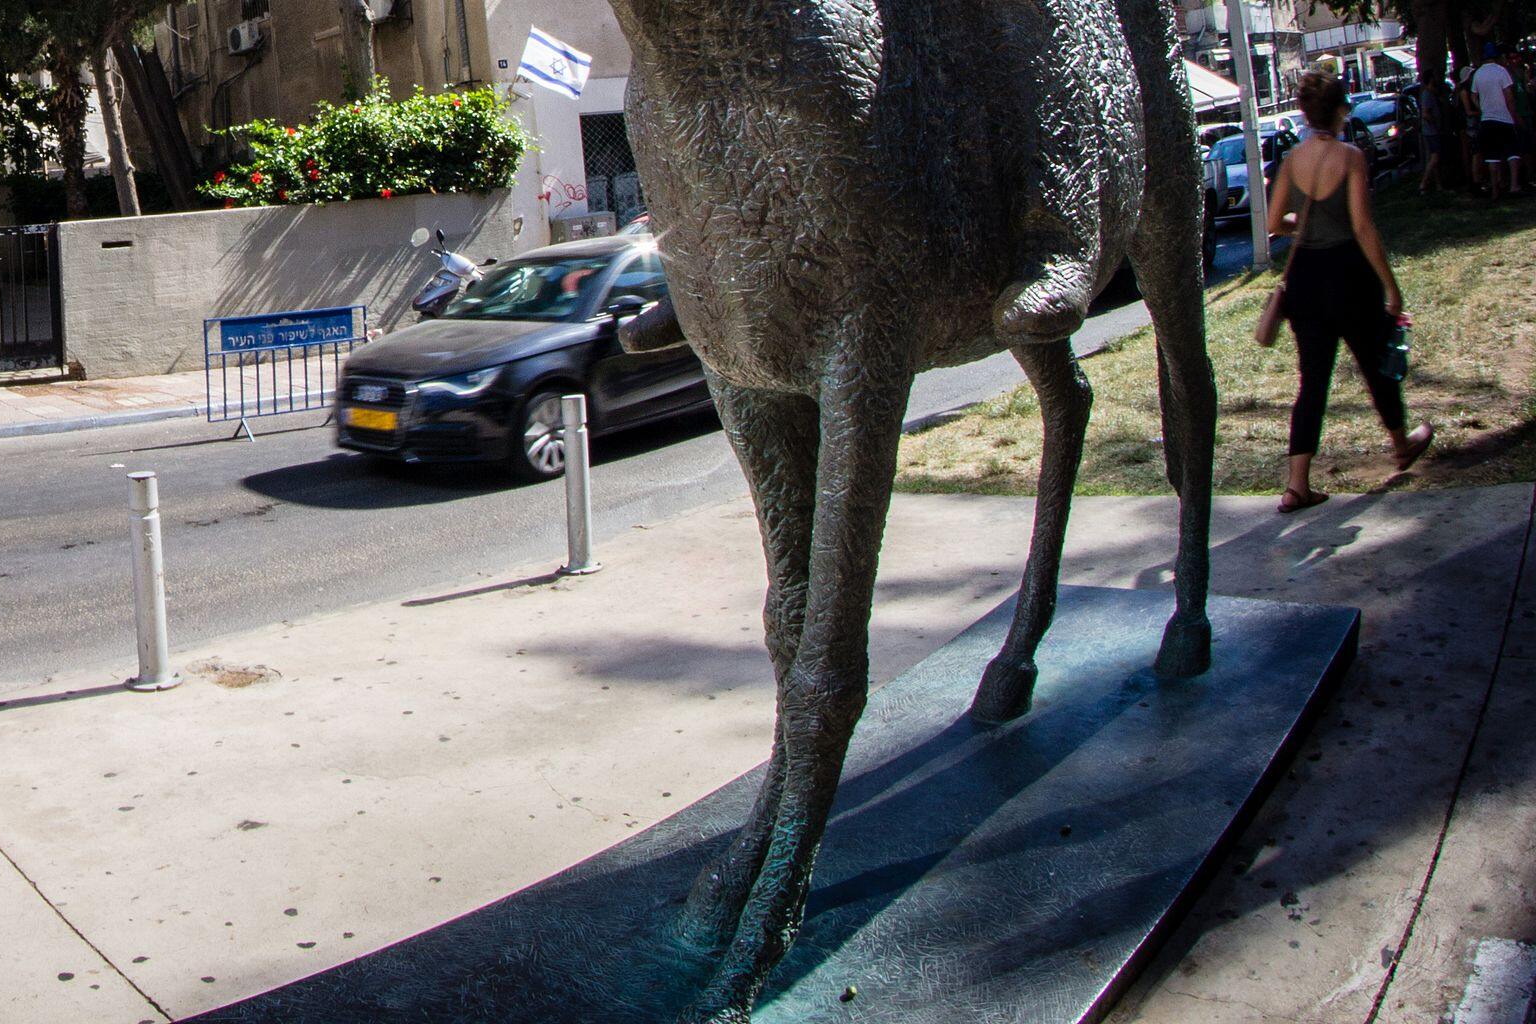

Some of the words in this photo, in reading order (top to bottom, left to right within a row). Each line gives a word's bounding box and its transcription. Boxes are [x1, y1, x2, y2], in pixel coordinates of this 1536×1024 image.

[278, 326, 315, 342] לשיפור
[318, 325, 347, 339] האגף
[227, 335, 255, 347] העיר
